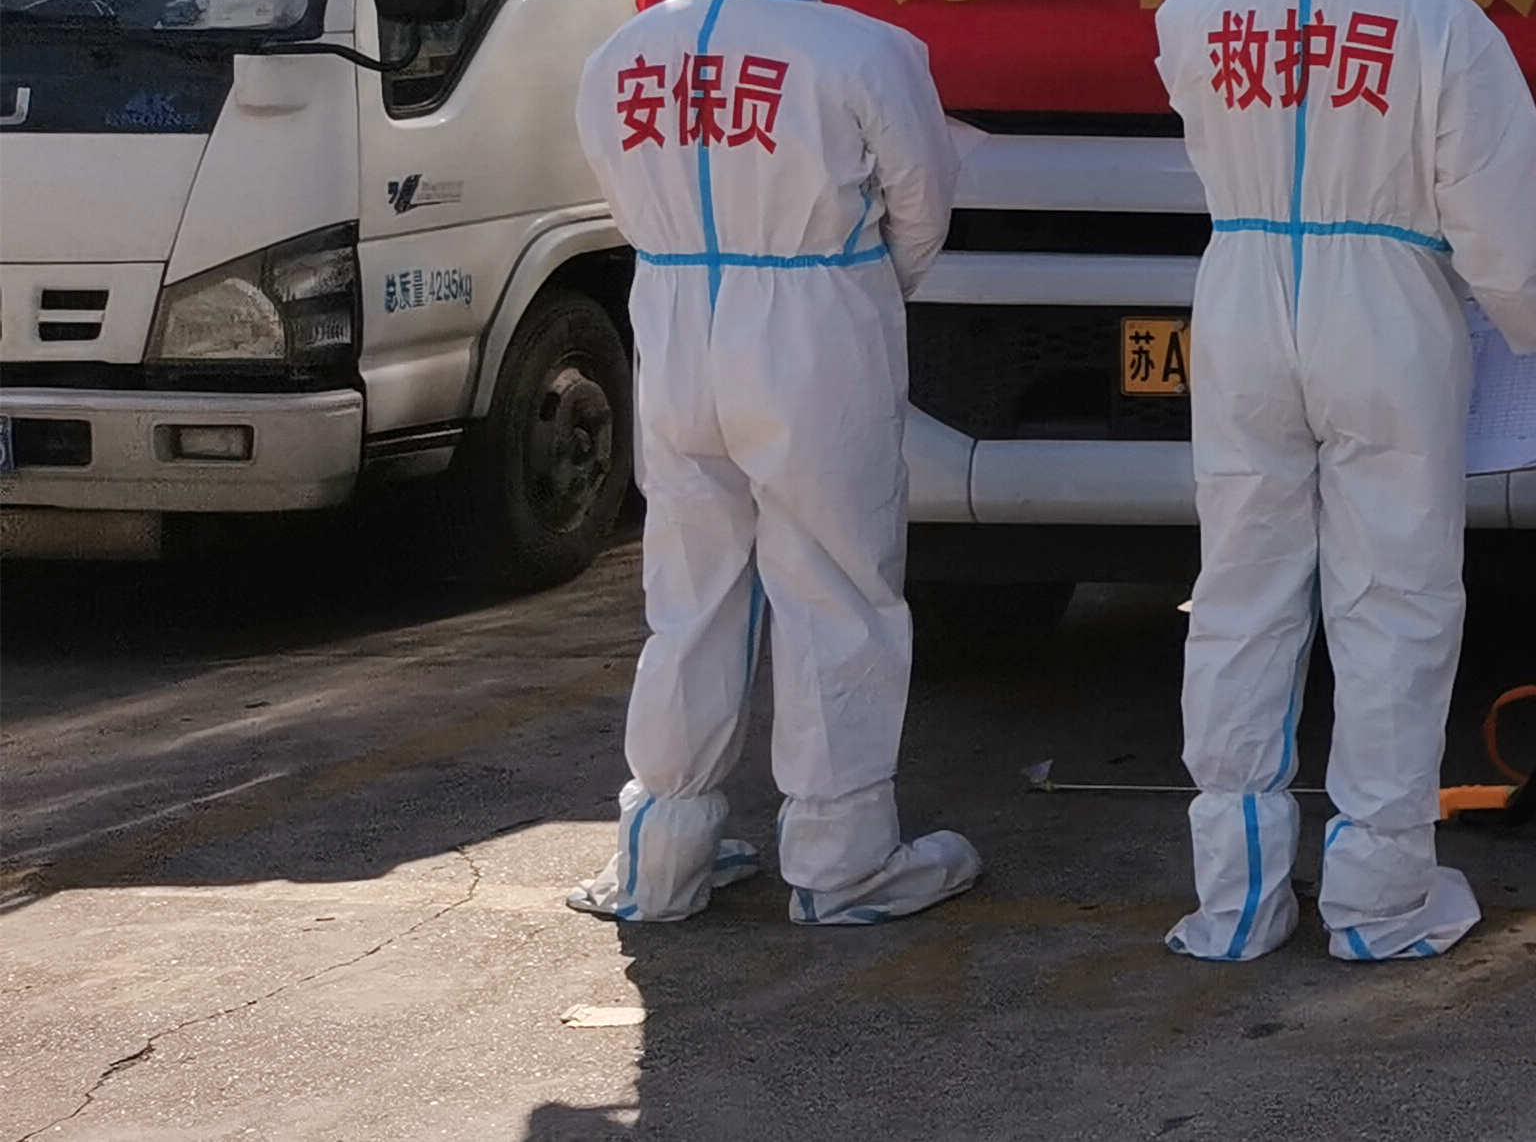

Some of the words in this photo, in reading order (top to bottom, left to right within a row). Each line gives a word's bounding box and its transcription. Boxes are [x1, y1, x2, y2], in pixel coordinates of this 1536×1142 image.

[617, 52, 790, 154] 安保员
[1208, 8, 1399, 117] 救护员
